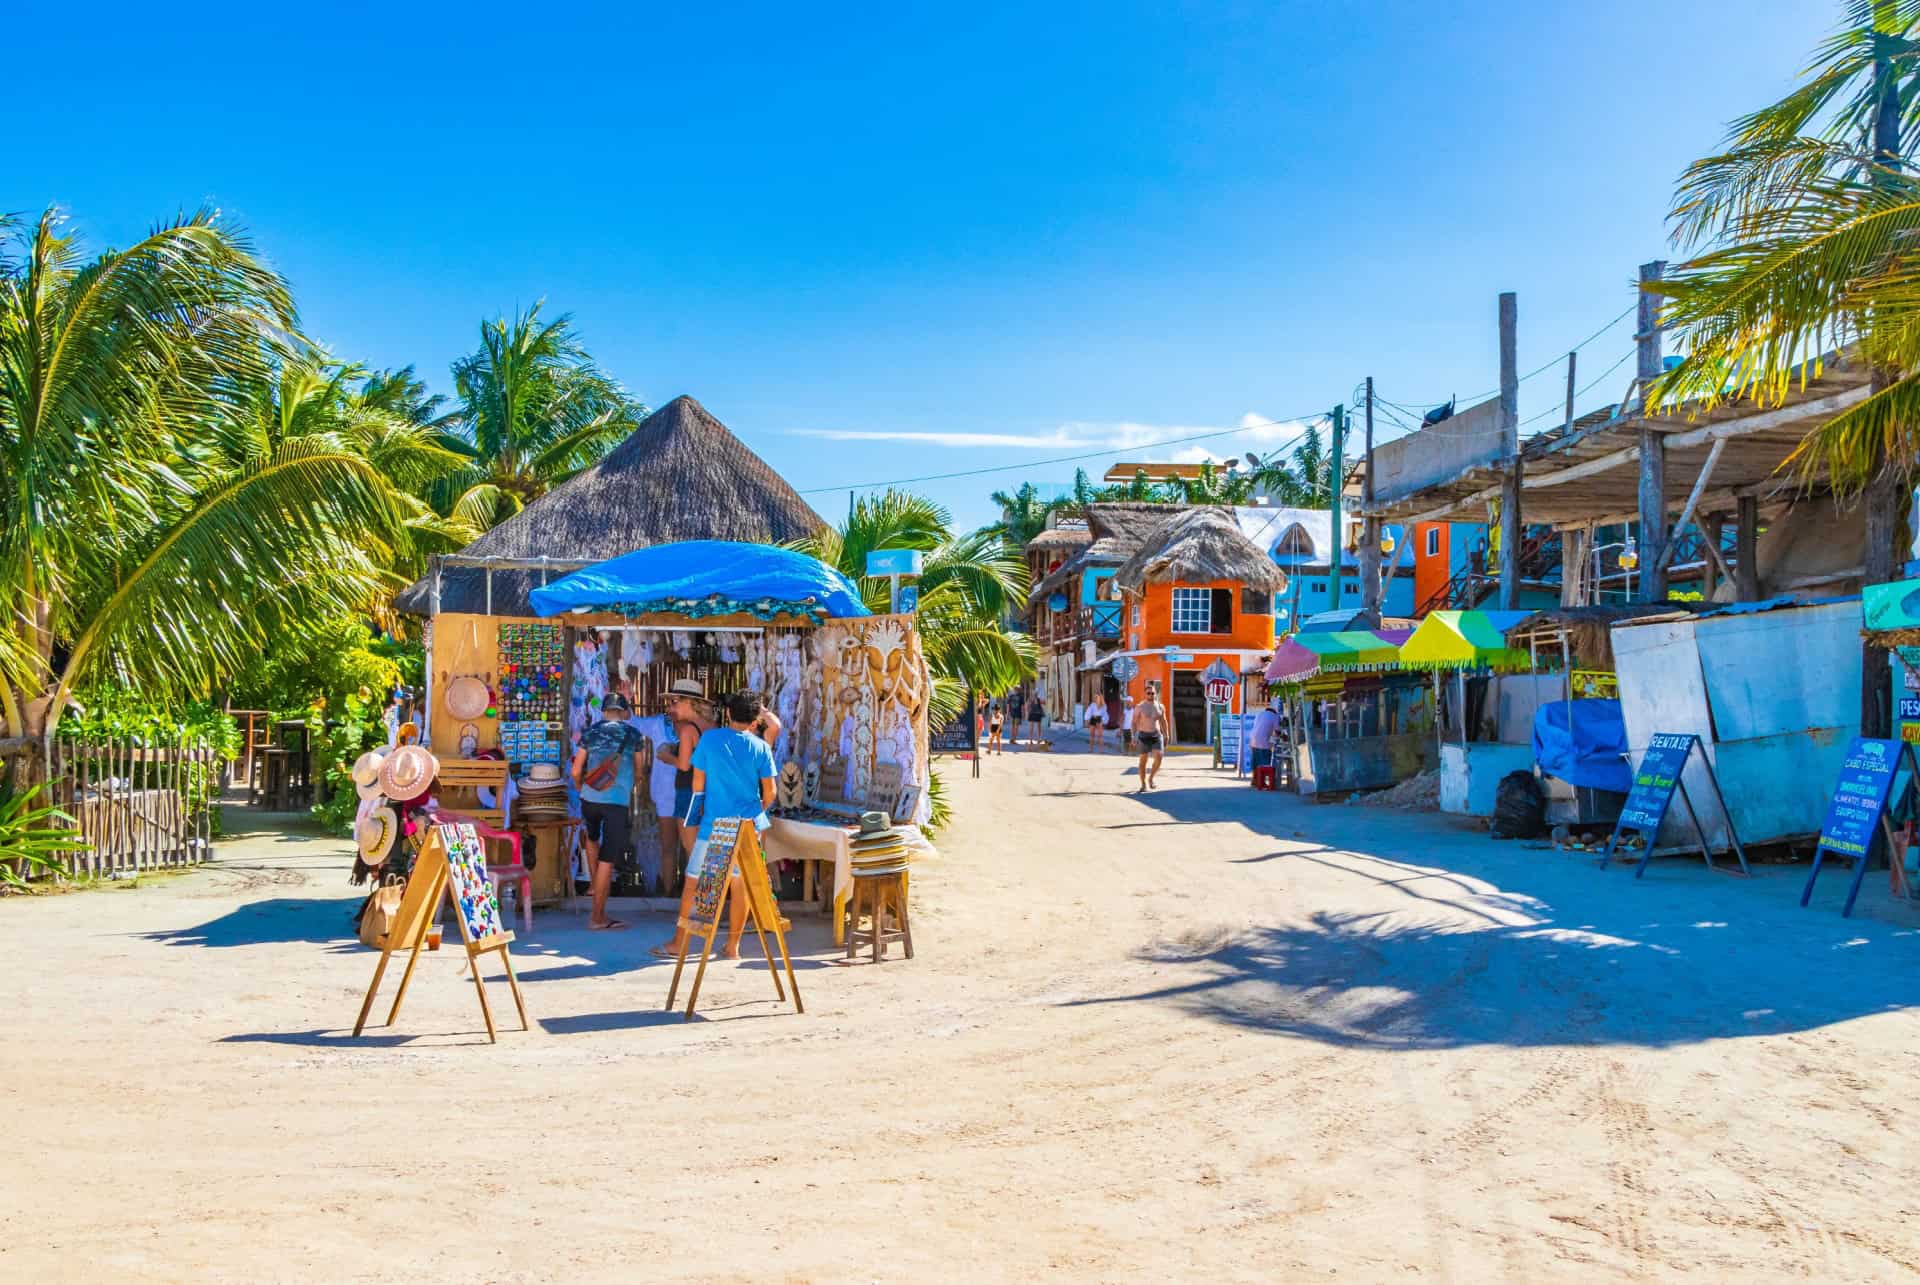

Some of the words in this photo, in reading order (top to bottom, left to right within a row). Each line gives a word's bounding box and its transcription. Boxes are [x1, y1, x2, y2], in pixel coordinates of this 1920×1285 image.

[1209, 684, 1230, 700] ALTO
[1901, 700, 1920, 716] PES
[1651, 736, 1680, 749] RENTA
[1678, 737, 1691, 751] DE
